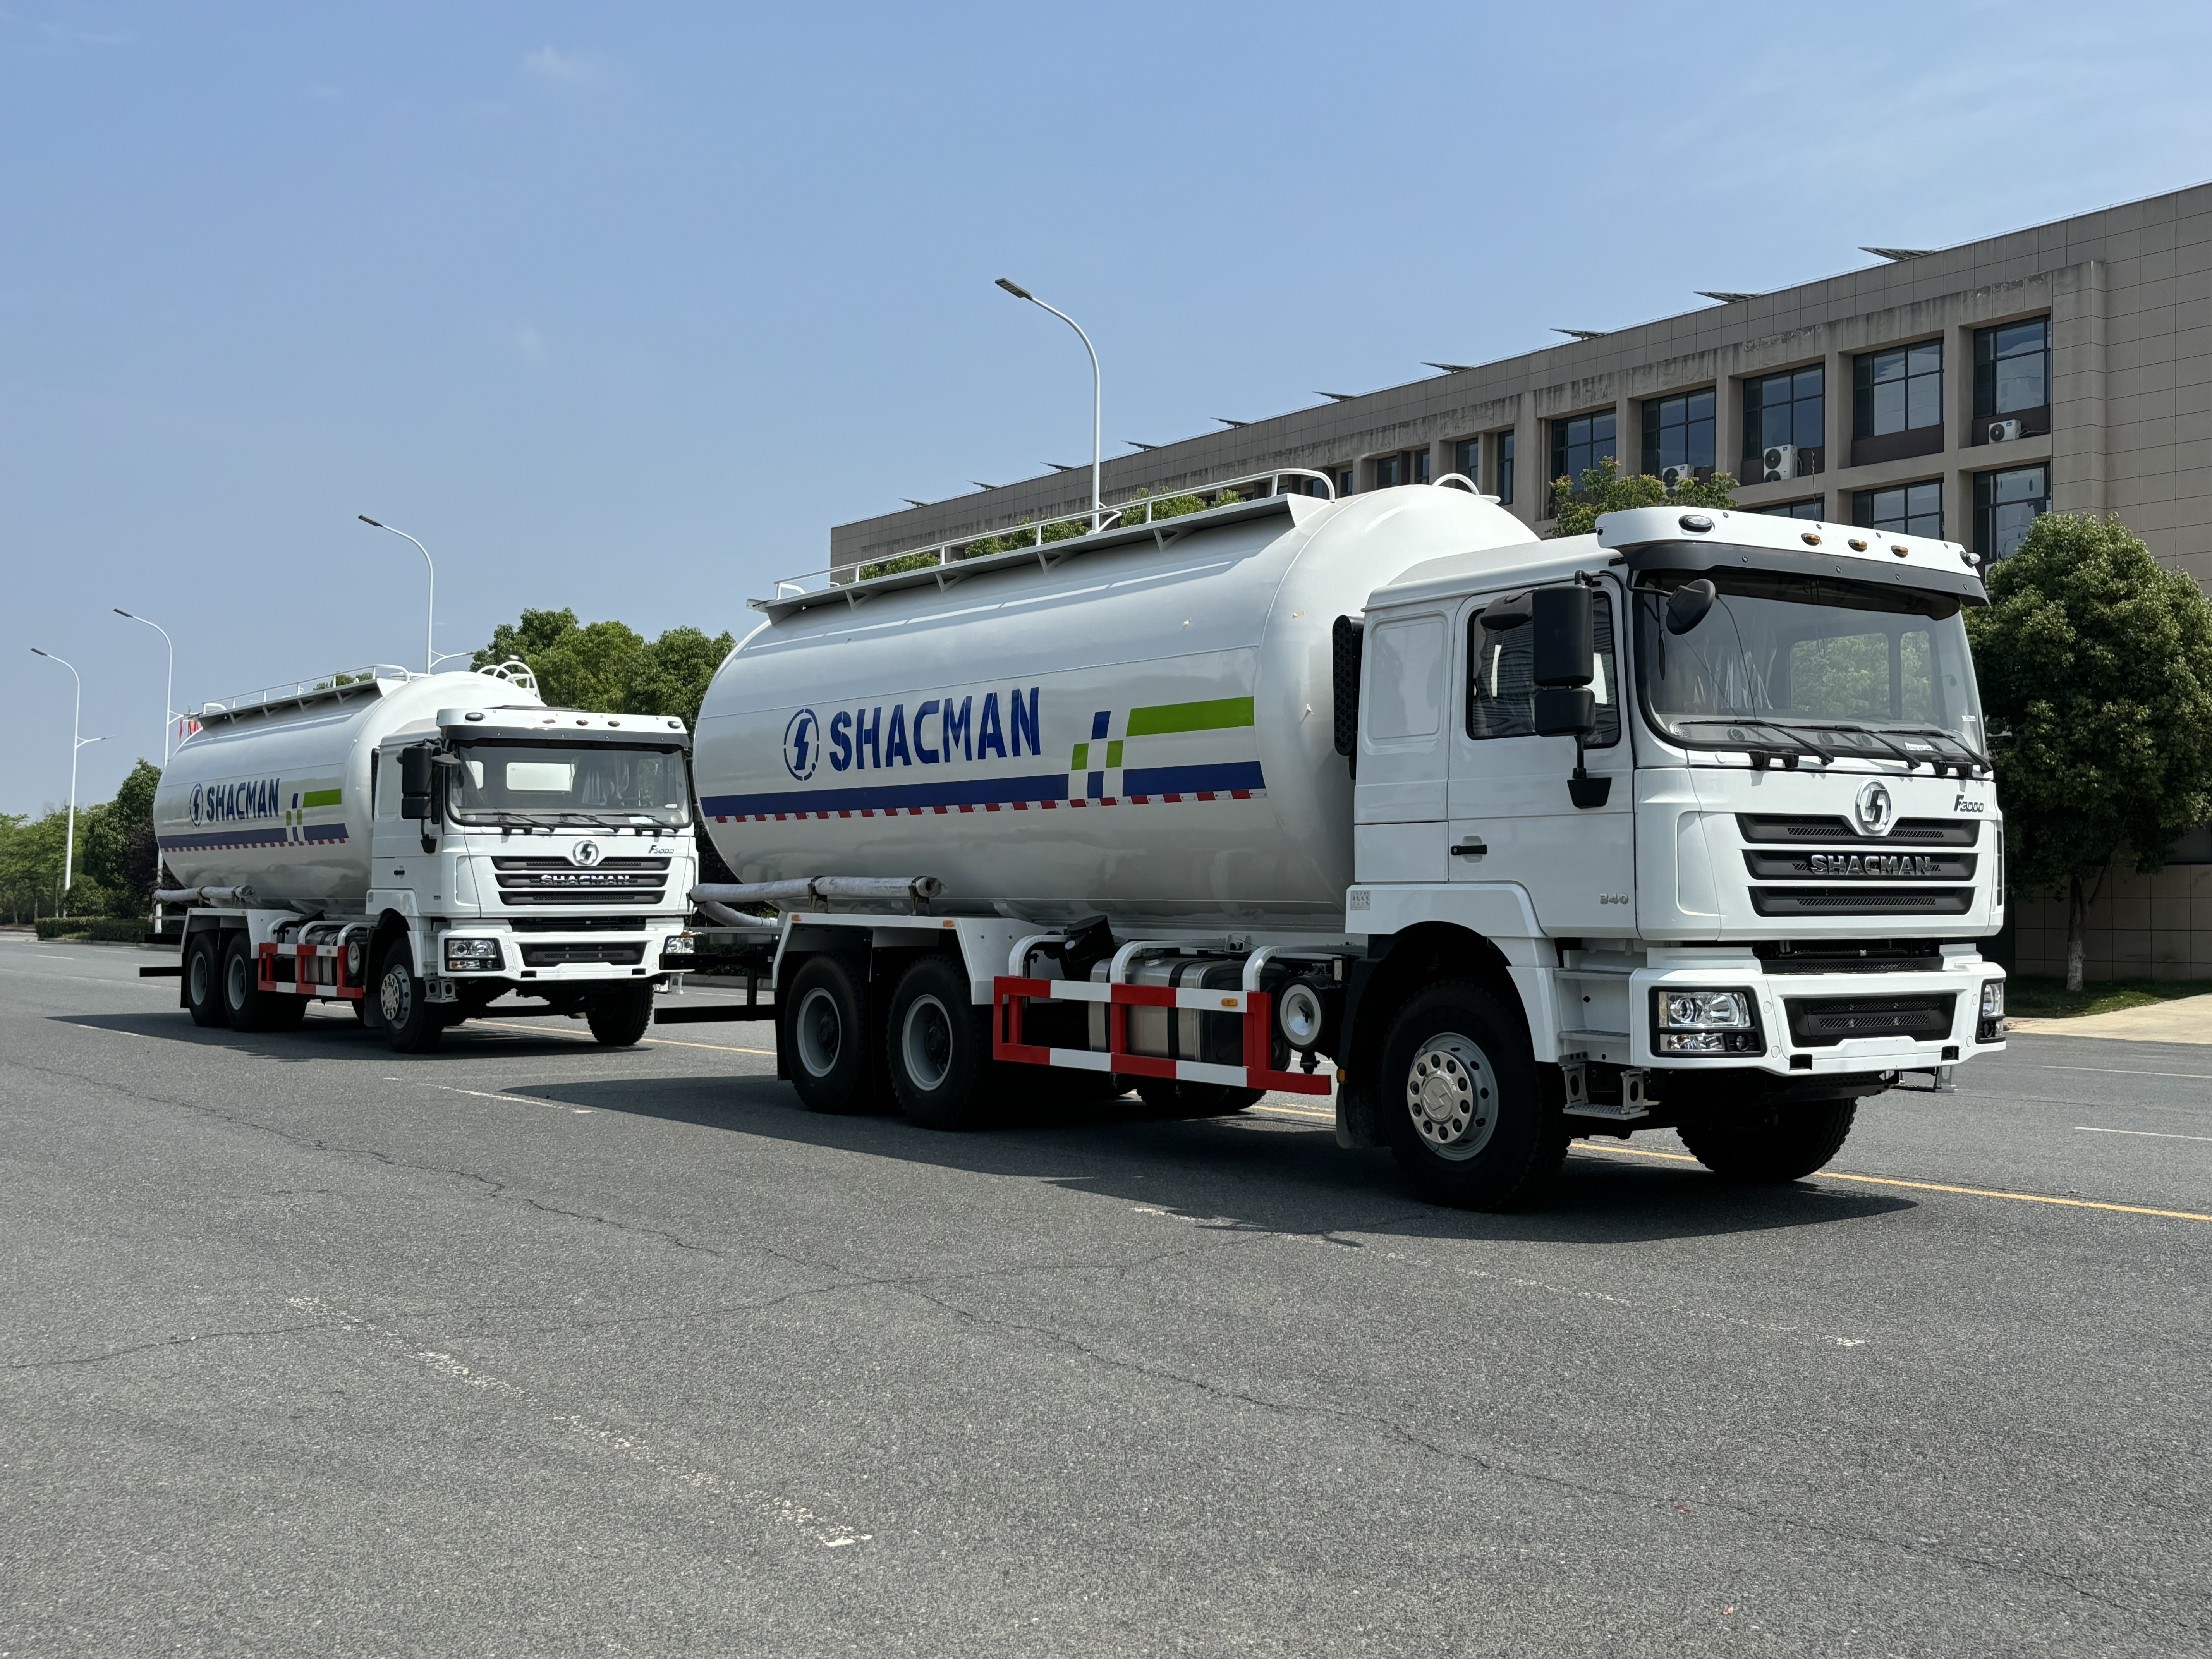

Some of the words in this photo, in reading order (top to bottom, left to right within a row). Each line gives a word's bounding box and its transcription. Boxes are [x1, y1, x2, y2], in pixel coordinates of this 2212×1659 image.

[829, 686, 1041, 771] SHACMAN
[206, 778, 280, 822] SHACMAN
[1953, 794, 1984, 812] F3000
[1811, 854, 1931, 875] SHACMAN
[541, 874, 629, 886] SHACMAN
